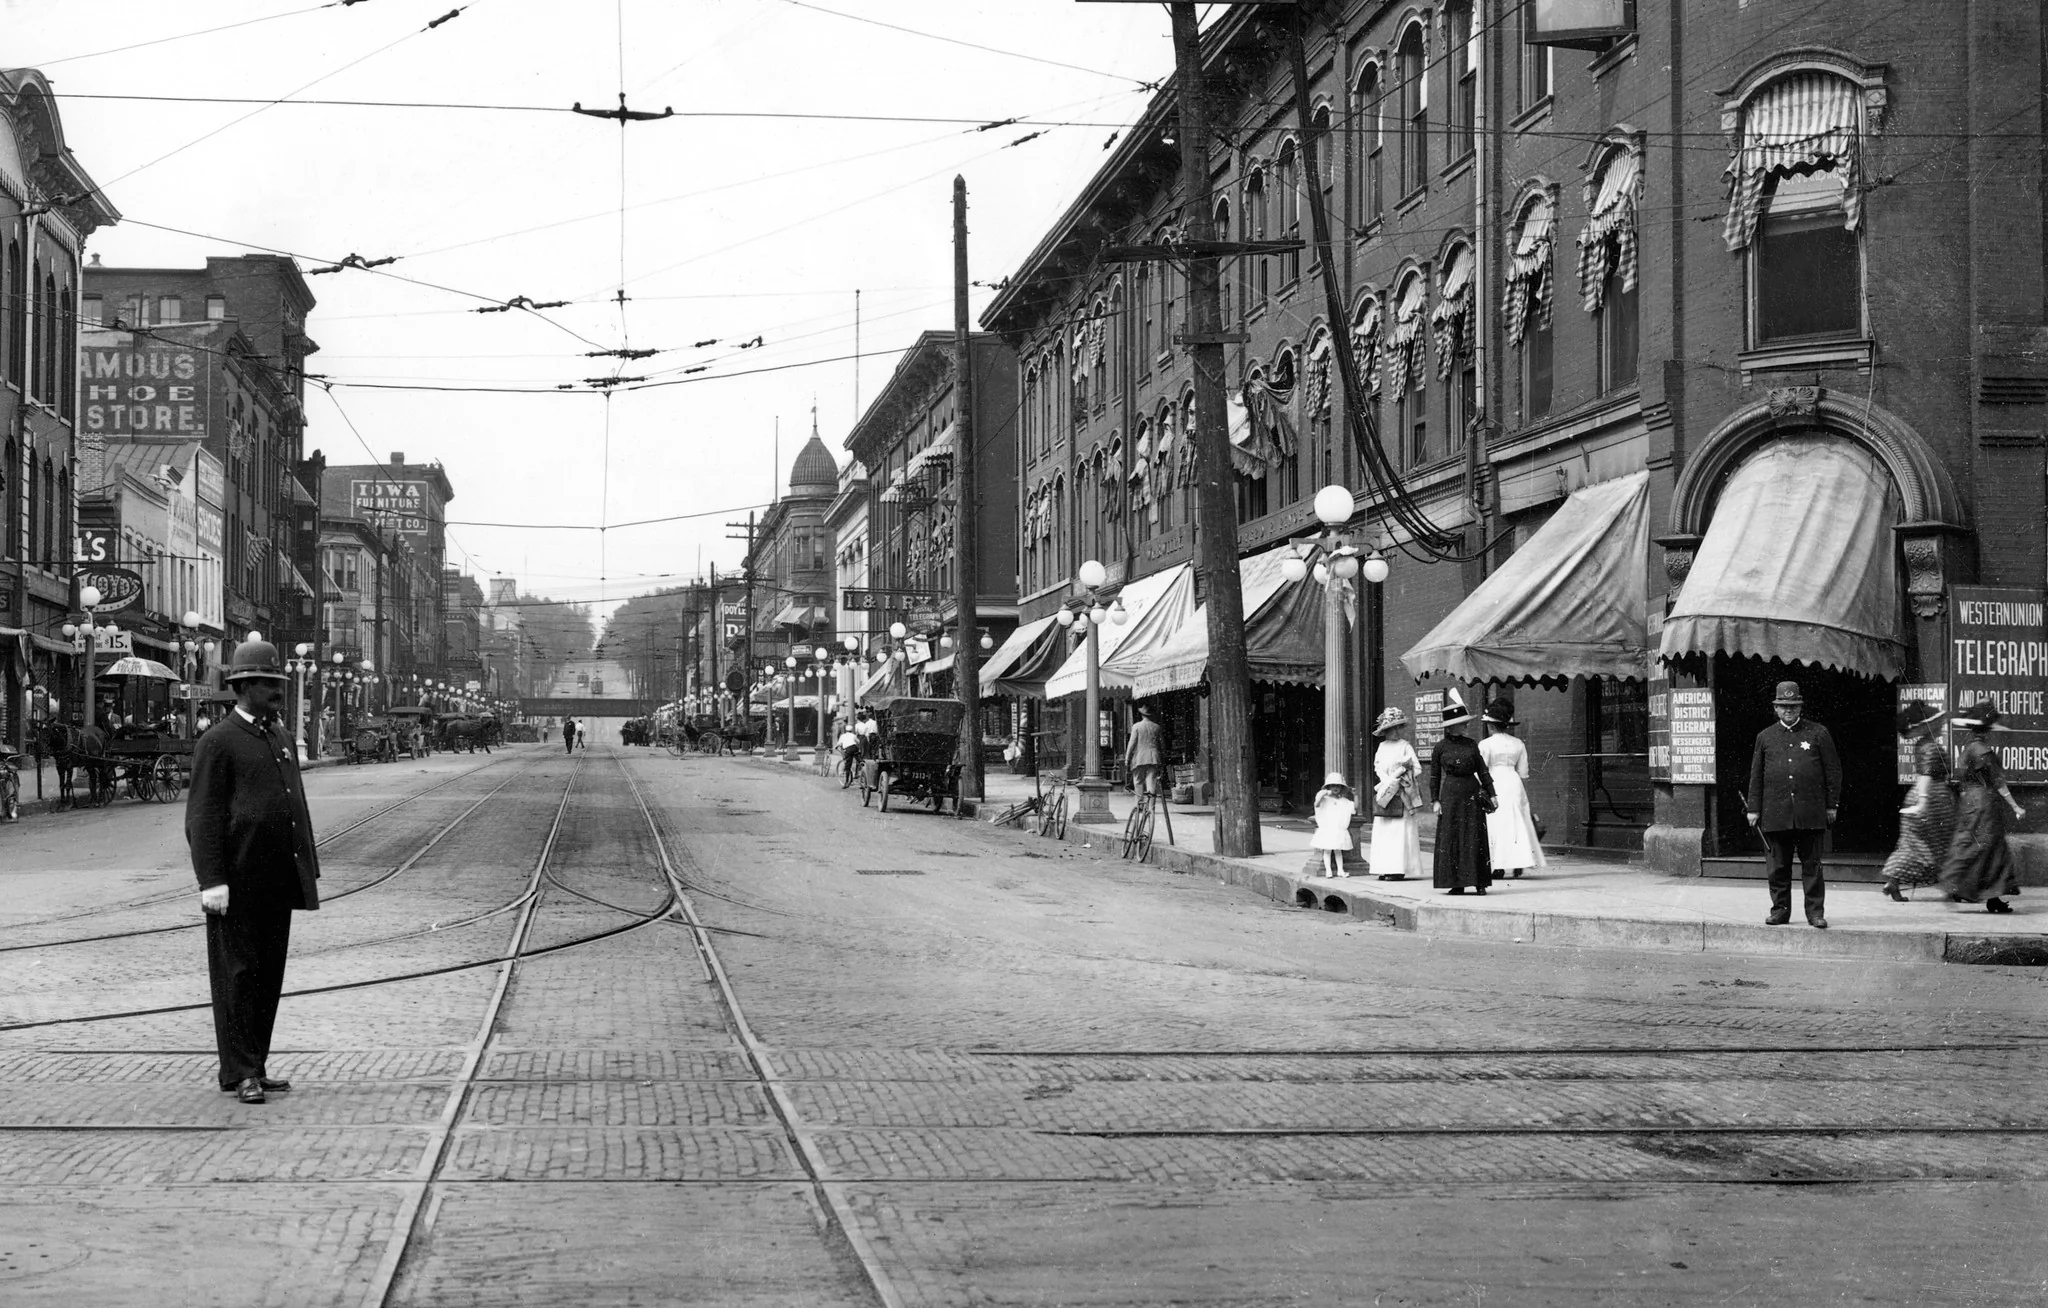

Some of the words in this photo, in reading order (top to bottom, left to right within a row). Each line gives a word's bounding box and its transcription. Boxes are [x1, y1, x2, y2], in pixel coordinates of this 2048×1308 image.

[89, 385, 195, 401] HOE
[87, 405, 204, 430] STORE.
[359, 484, 420, 497] IOWA
[357, 498, 420, 508] FURNITURE
[198, 506, 222, 548] SHOES
[406, 518, 424, 528] CO.
[863, 594, 877, 609] &
[1959, 600, 2010, 626] WESTERN
[2011, 602, 2043, 627] UNION
[1954, 639, 2048, 677] TELEGRAPH
[1673, 692, 1712, 704] AMERICAN
[1900, 688, 1945, 701] AMERICAN
[1959, 690, 1974, 708] AND
[1976, 690, 2008, 714] CBLE
[2010, 691, 2044, 715] OFFICE
[1674, 707, 1710, 719] DISTRICT
[1672, 721, 1715, 733] TELEGRAPH
[1672, 737, 1712, 746] MESSENGERS
[1677, 747, 1715, 755] FURNISHED
[1672, 755, 1682, 763] FOR
[1683, 755, 1706, 763] DELIVERY
[1707, 755, 1716, 763] OF
[2002, 746, 2048, 770] ORDERS
